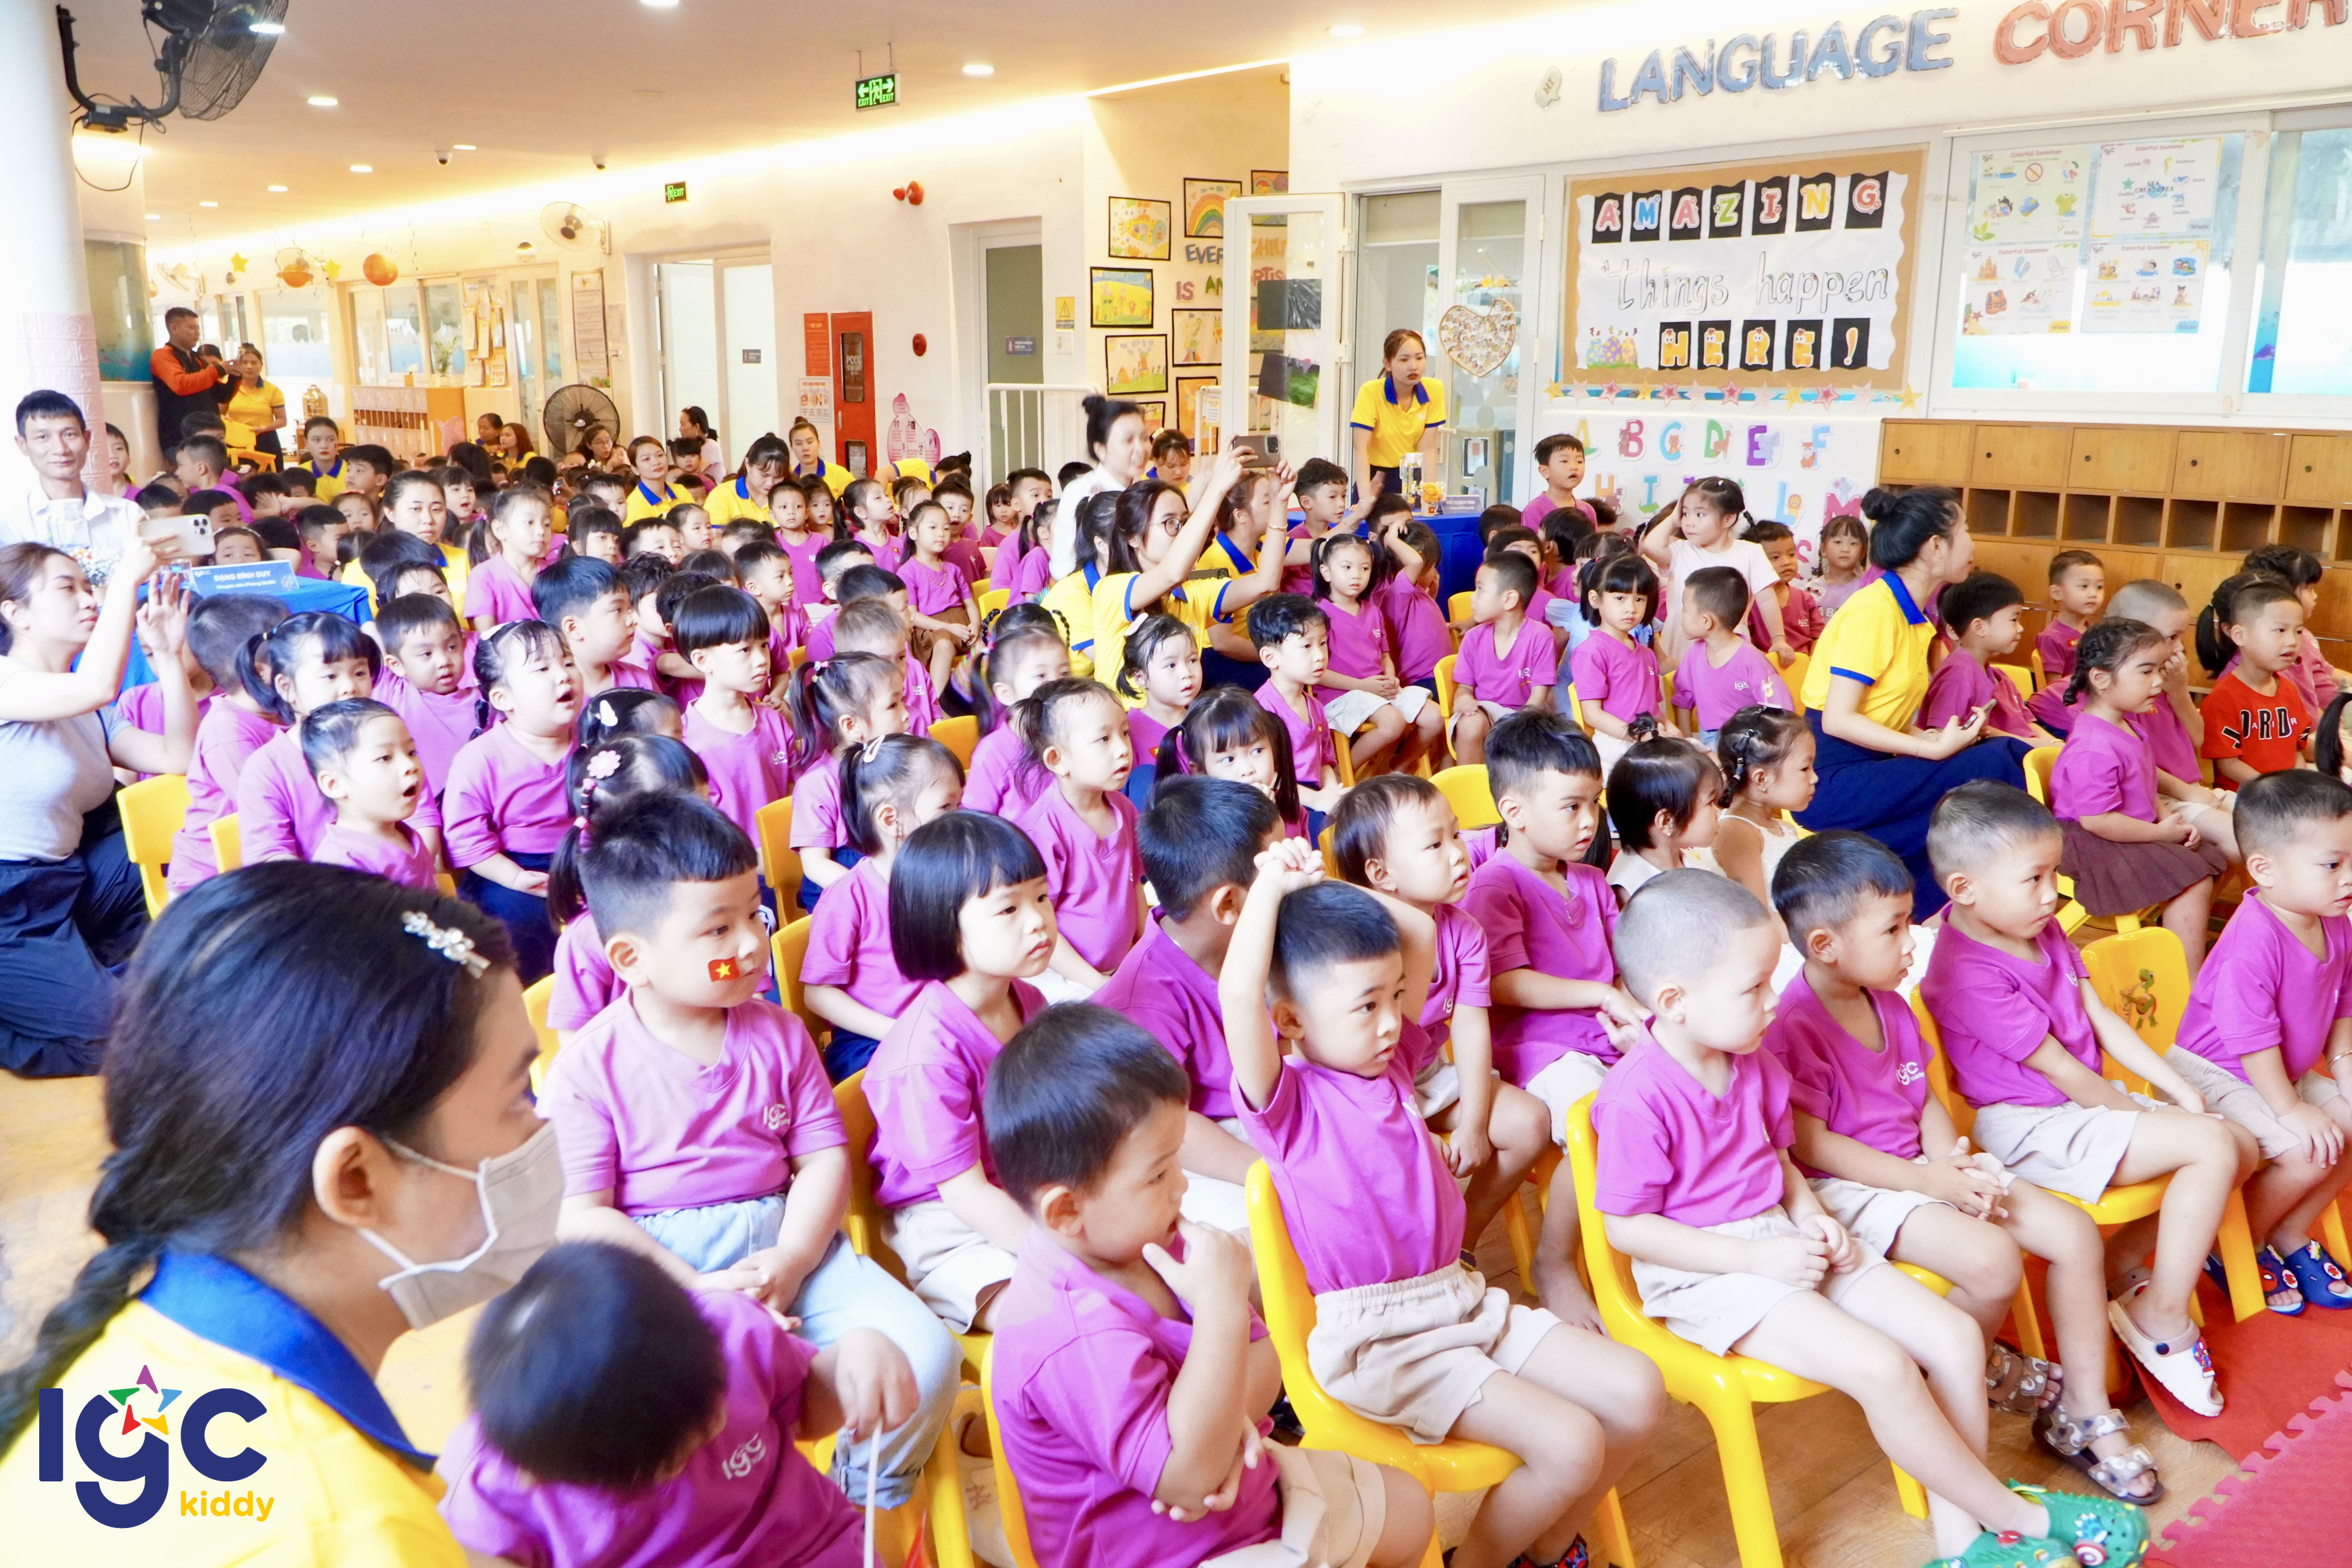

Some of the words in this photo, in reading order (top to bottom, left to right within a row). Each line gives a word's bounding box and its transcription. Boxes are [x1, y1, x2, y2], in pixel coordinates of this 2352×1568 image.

[1598, 7, 1959, 112] LANGUAGE
[858, 97, 869, 107] EXIT
[882, 92, 894, 103] EXIT
[674, 188, 684, 197] EXIT
[1595, 179, 1882, 232] AMAZING
[1176, 281, 1194, 301] IS
[1756, 251, 1888, 315] happen
[1660, 327, 1859, 368] HERE!
[1622, 419, 1644, 458] B
[1659, 421, 1682, 461] C
[1704, 419, 1726, 458] D
[1747, 425, 1769, 466] E
[1811, 426, 1830, 467] F
[1644, 475, 1658, 507] I
[1775, 482, 1796, 525] L
[1823, 493, 1862, 526] M
